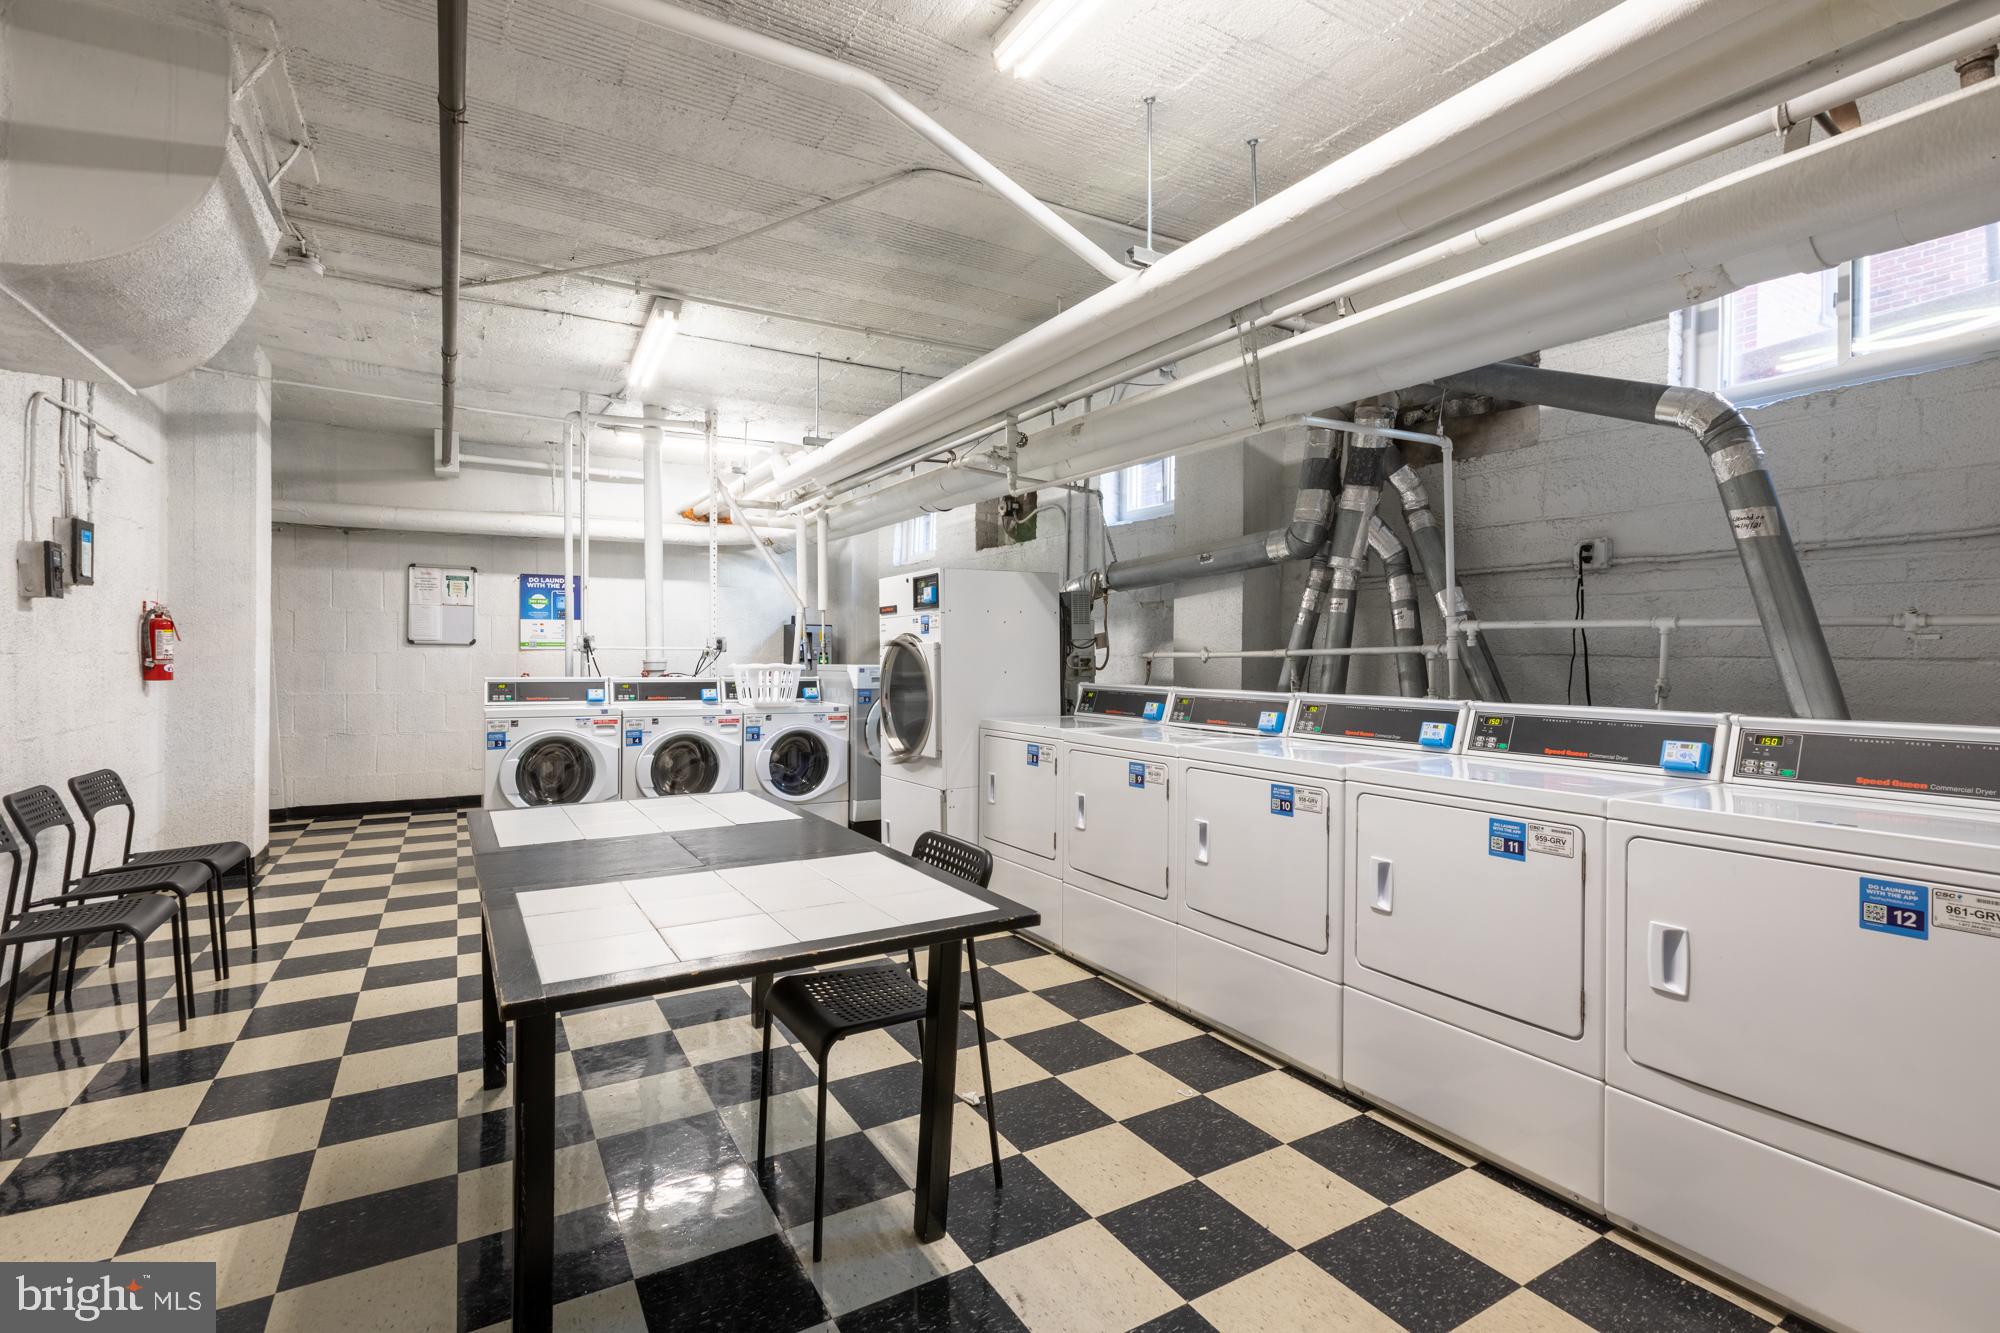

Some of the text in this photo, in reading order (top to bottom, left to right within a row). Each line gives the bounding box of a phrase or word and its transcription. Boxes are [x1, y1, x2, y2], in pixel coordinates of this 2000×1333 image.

[1761, 738, 1778, 746] 150
[1856, 776, 1997, 796] Speed Queen Commercial Dryer
[1281, 801, 1290, 810] 10
[1535, 834, 1567, 846] 959-GRV
[1508, 841, 1519, 853] 11
[1881, 886, 1916, 895] LAUNDRY
[1893, 910, 1917, 927] 12
